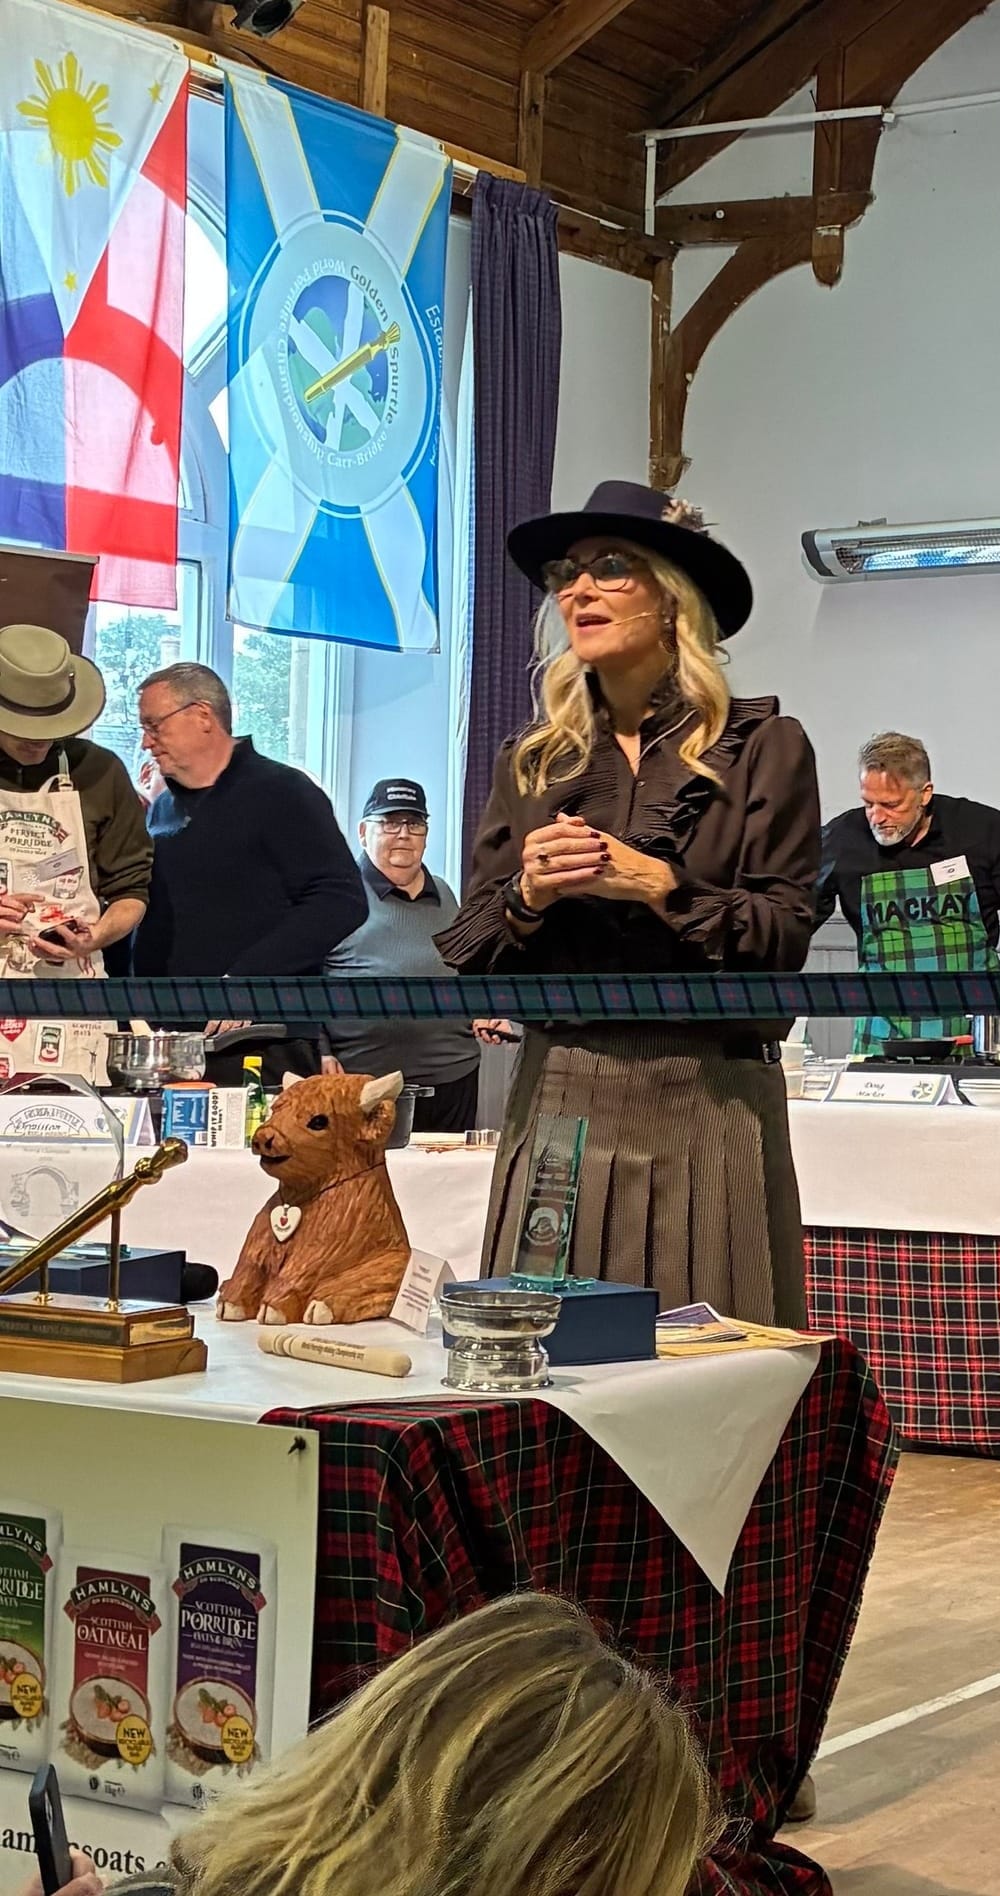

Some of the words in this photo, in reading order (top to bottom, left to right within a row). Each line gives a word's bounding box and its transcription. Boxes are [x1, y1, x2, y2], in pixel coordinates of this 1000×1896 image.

[312, 257, 346, 276] World
[350, 265, 389, 322] Golden
[388, 346, 400, 426] Spurtle
[327, 431, 388, 468] Carr-Bridge
[866, 891, 971, 924] MACKAY
[0, 1525, 43, 1552] MLYNS
[0, 1577, 43, 1600] RIDGE
[183, 1561, 257, 1590] HAMLYNS
[75, 1581, 150, 1611] HAMLYNS
[195, 1600, 241, 1618] SCOTTISH
[90, 1616, 132, 1631] SCOTTISH
[181, 1609, 257, 1641] PORRIDGE
[77, 1624, 147, 1651] OATMEAL
[16, 1684, 38, 1694] NEW
[123, 1727, 146, 1738] NEW
[227, 1728, 249, 1738] NEW
